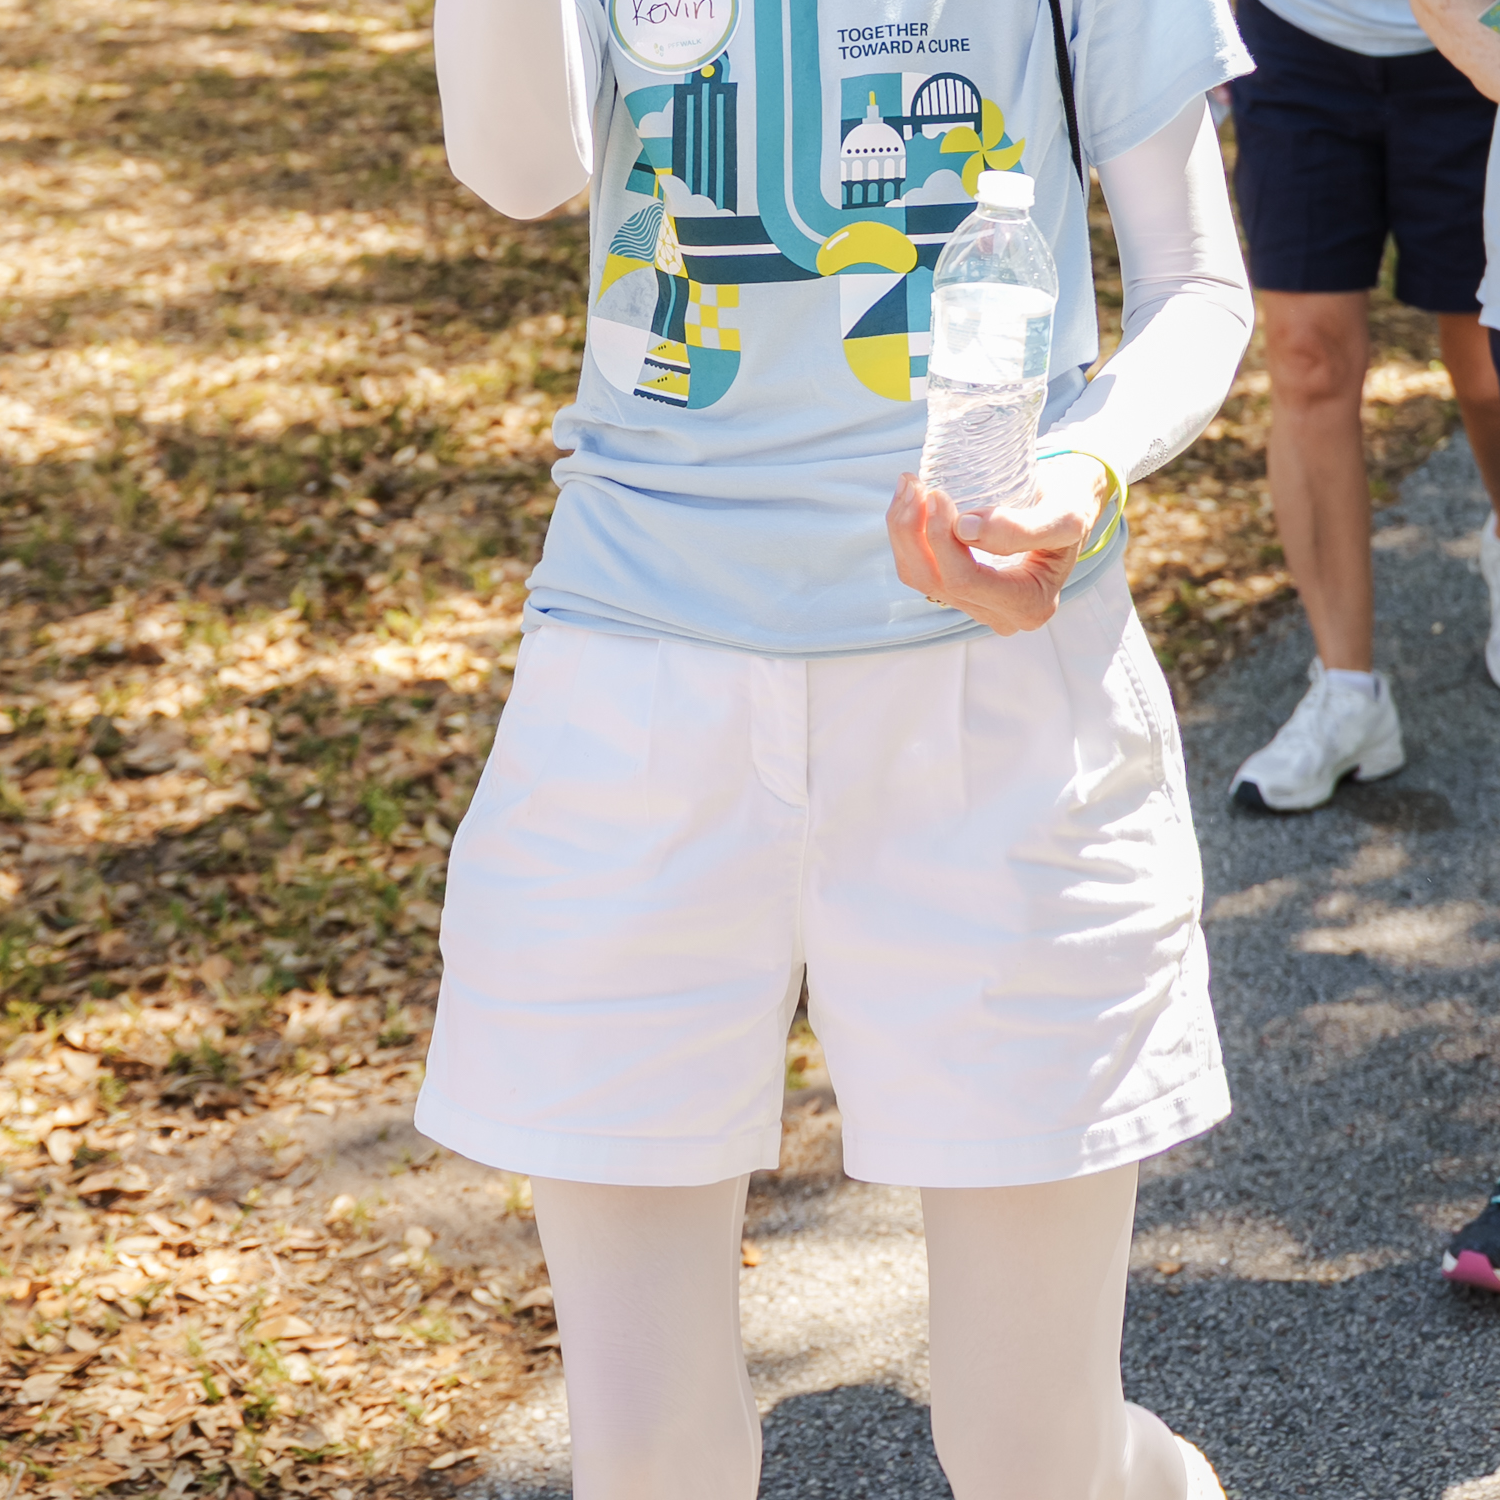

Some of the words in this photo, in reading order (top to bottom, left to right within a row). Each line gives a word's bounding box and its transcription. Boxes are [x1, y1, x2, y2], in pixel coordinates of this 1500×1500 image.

[837, 23, 929, 43] TOGETHER
[668, 38, 702, 49] PFFWALK
[838, 40, 913, 60] TOWARD
[916, 40, 925, 54] A
[928, 38, 970, 53] CURE
